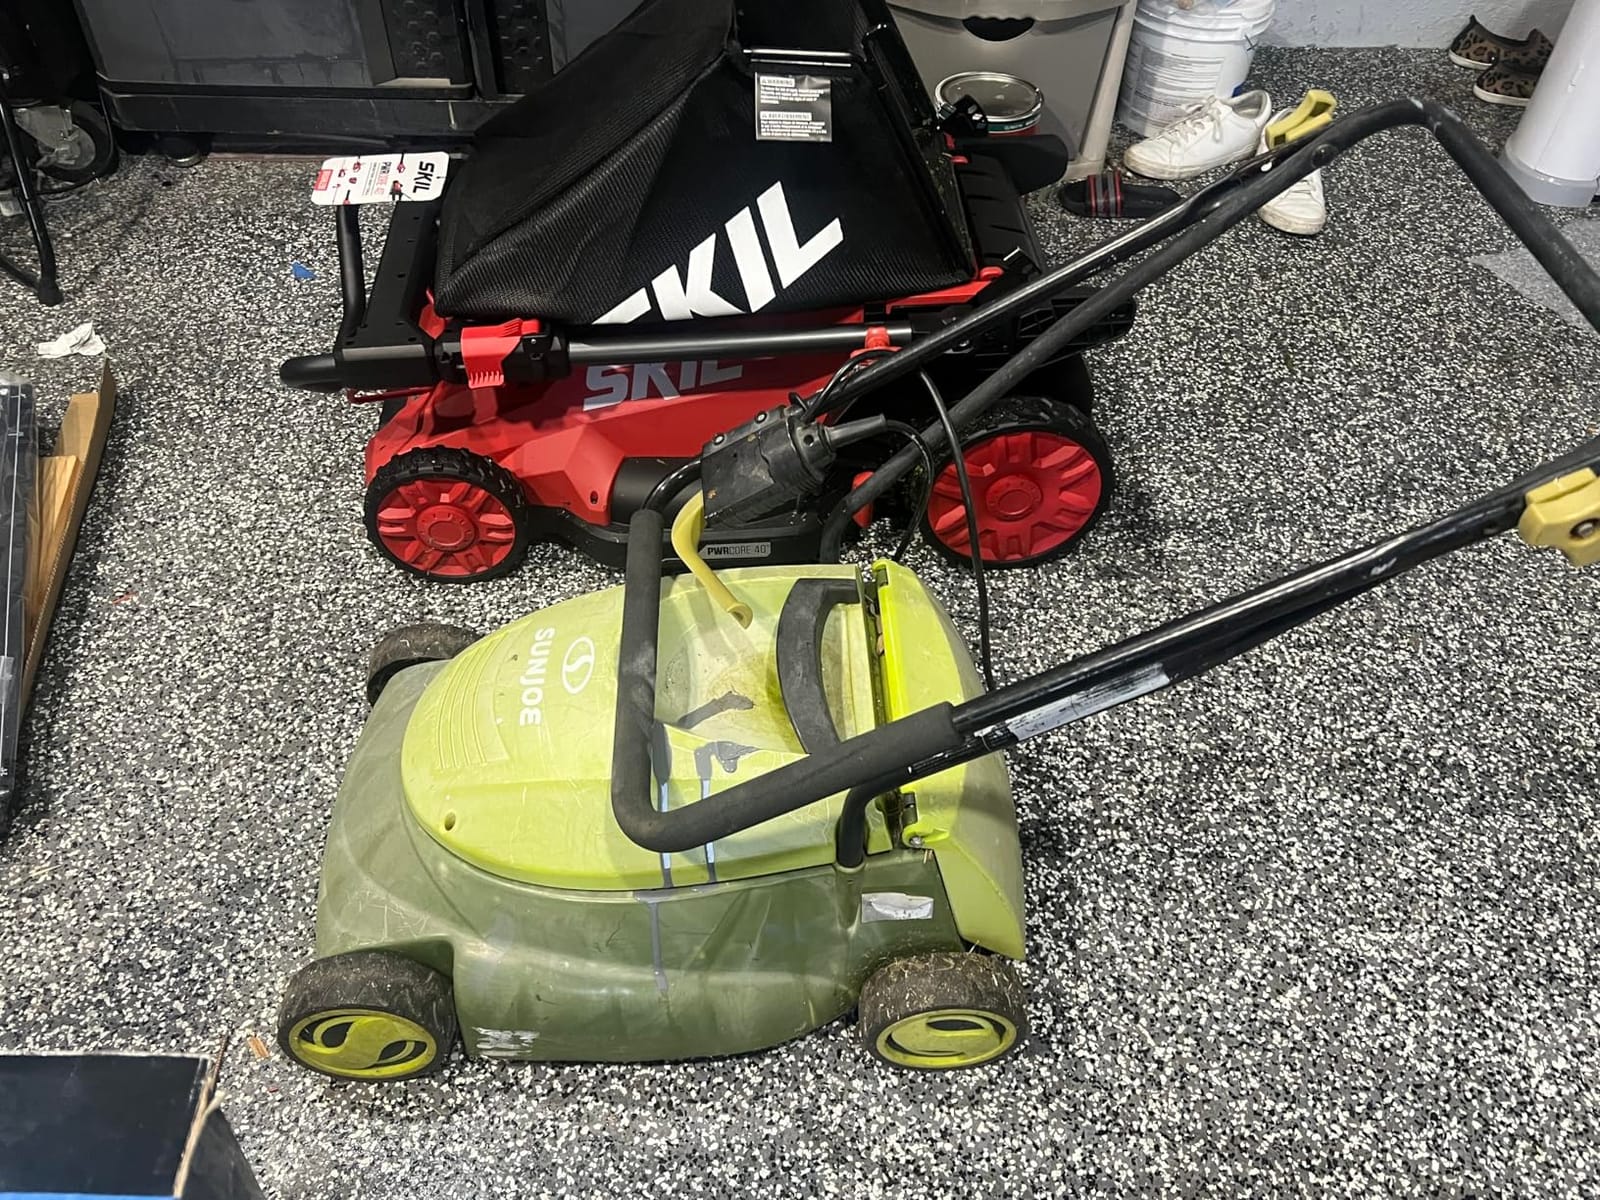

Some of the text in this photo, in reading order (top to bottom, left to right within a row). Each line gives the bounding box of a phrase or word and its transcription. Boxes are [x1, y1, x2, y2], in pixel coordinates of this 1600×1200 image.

[412, 161, 434, 193] SKIL
[591, 181, 844, 325] KIL
[708, 545, 751, 555] PWRCORE
[519, 627, 555, 726] SUNJOE
